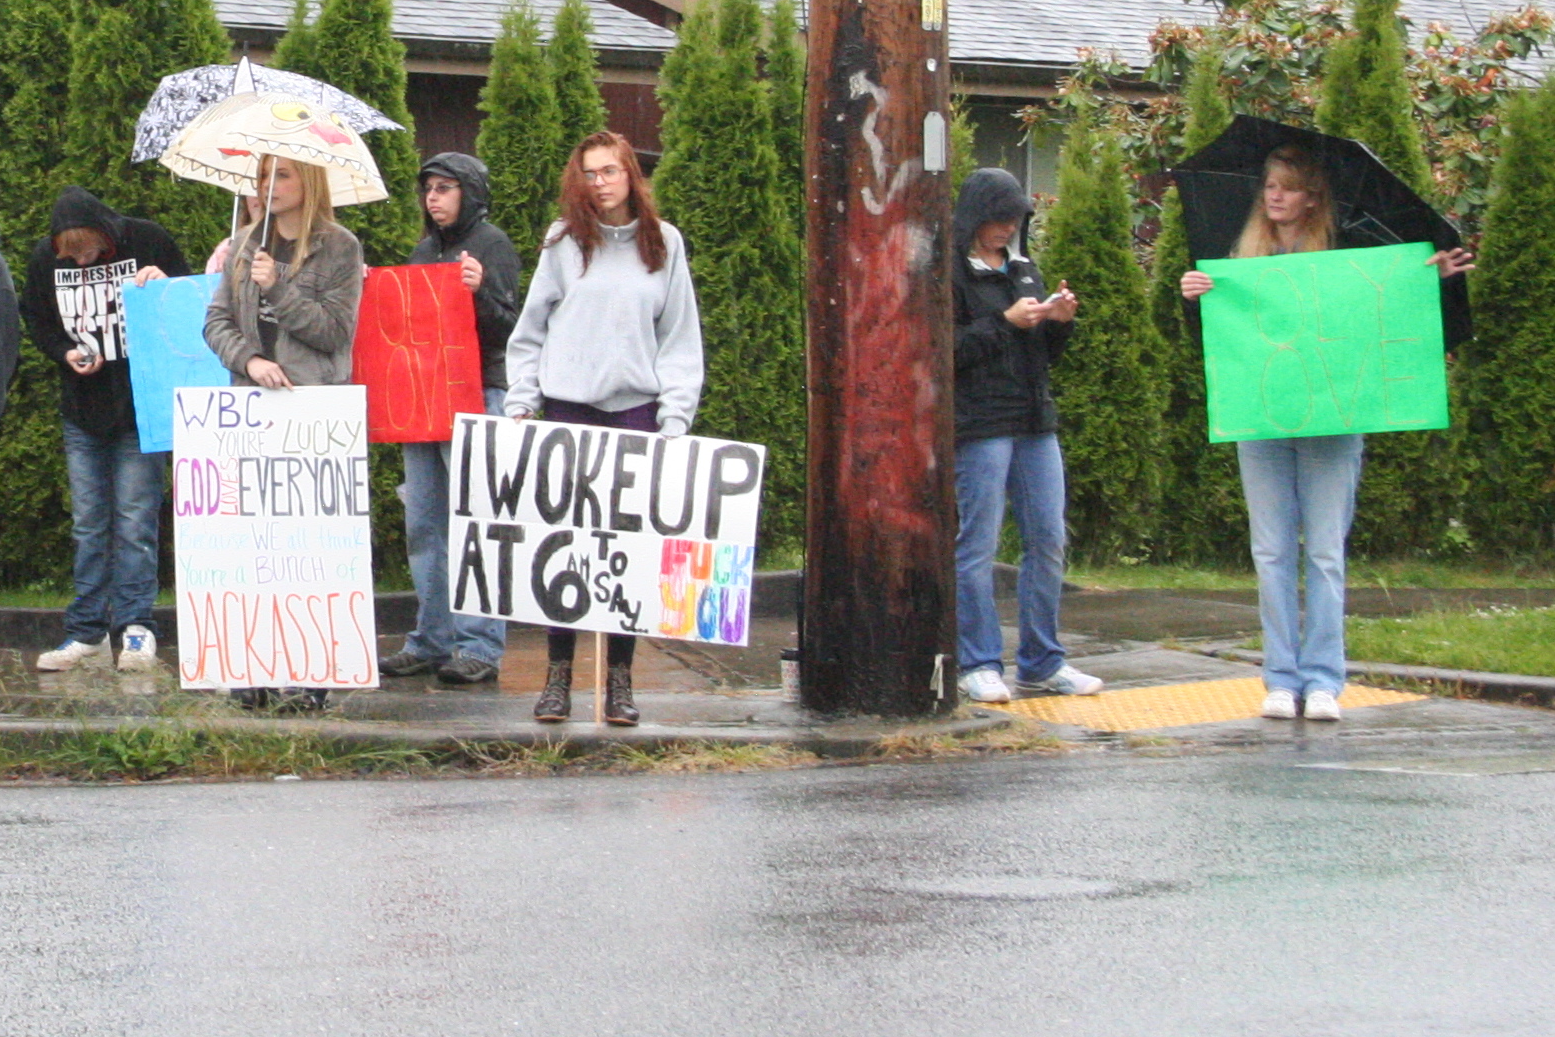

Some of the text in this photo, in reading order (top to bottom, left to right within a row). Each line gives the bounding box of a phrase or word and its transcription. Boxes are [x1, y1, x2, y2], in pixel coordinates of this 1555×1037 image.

[57, 262, 134, 284] IMPRESSIVE
[1255, 256, 1401, 348] OLY
[376, 268, 444, 346] OLY
[176, 390, 274, 433] WBC,
[1211, 338, 1429, 437] LOVE
[282, 418, 362, 456] LUCKY
[174, 457, 370, 517] GOD LOVES EVERYONE
[455, 418, 761, 540] I WOKE UP
[251, 521, 281, 551] WE
[235, 566, 247, 585] a
[335, 555, 360, 581] of
[453, 521, 526, 616] AT
[660, 537, 754, 587] FUCK
[181, 590, 373, 686] JACKASSES
[658, 580, 748, 644] YOU
